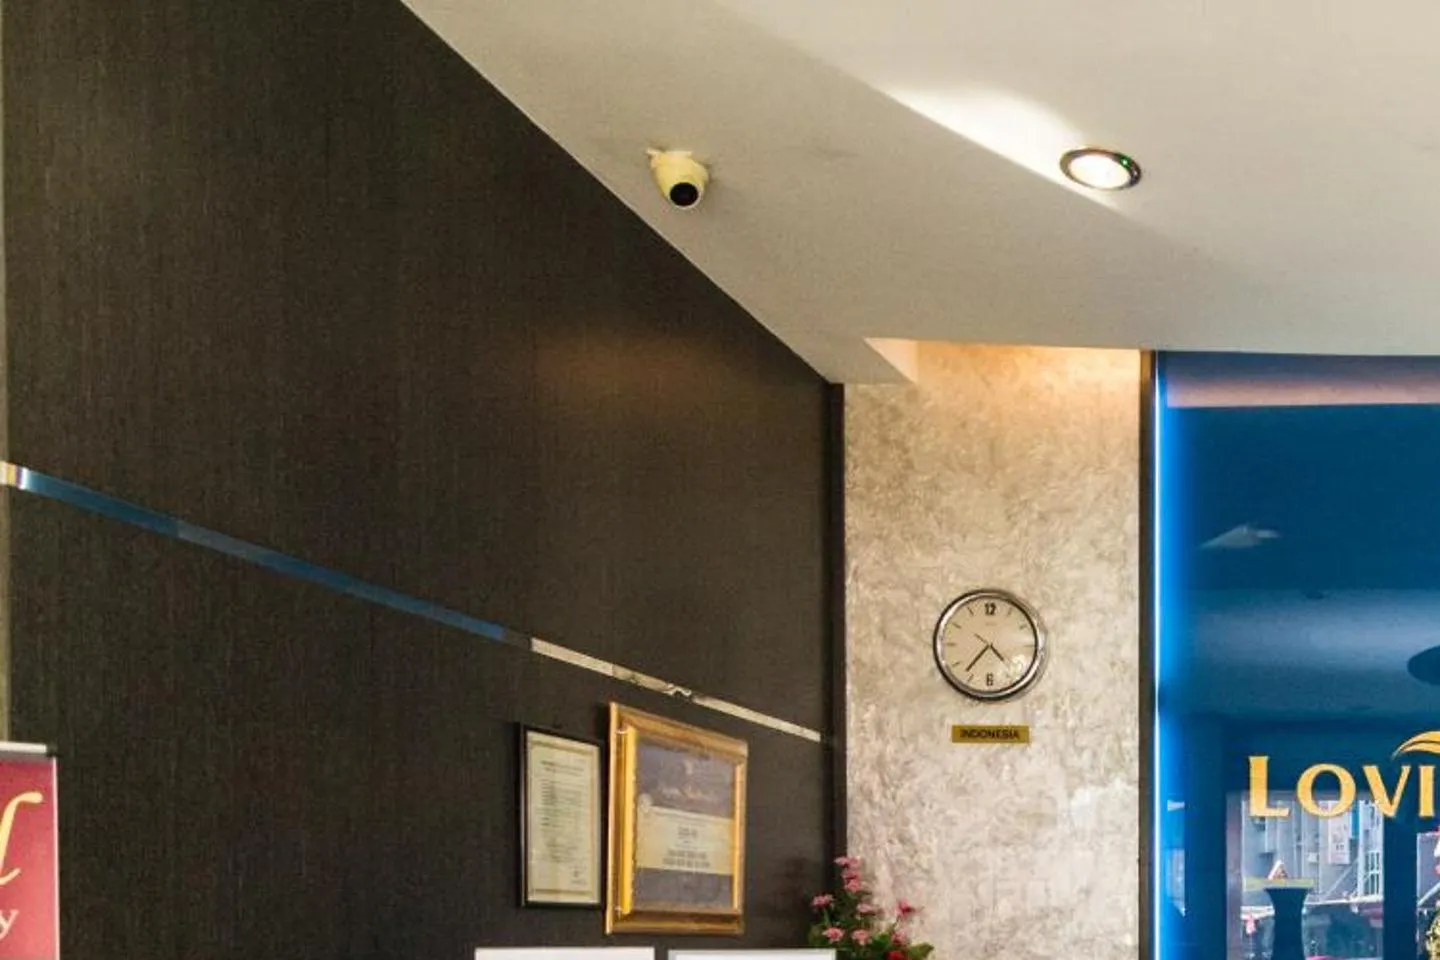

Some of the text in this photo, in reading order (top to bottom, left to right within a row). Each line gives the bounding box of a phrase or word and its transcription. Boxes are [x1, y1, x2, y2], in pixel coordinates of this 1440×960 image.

[984, 602, 997, 616] 12
[985, 673, 994, 687] 6
[960, 728, 1020, 740] INDONESIA
